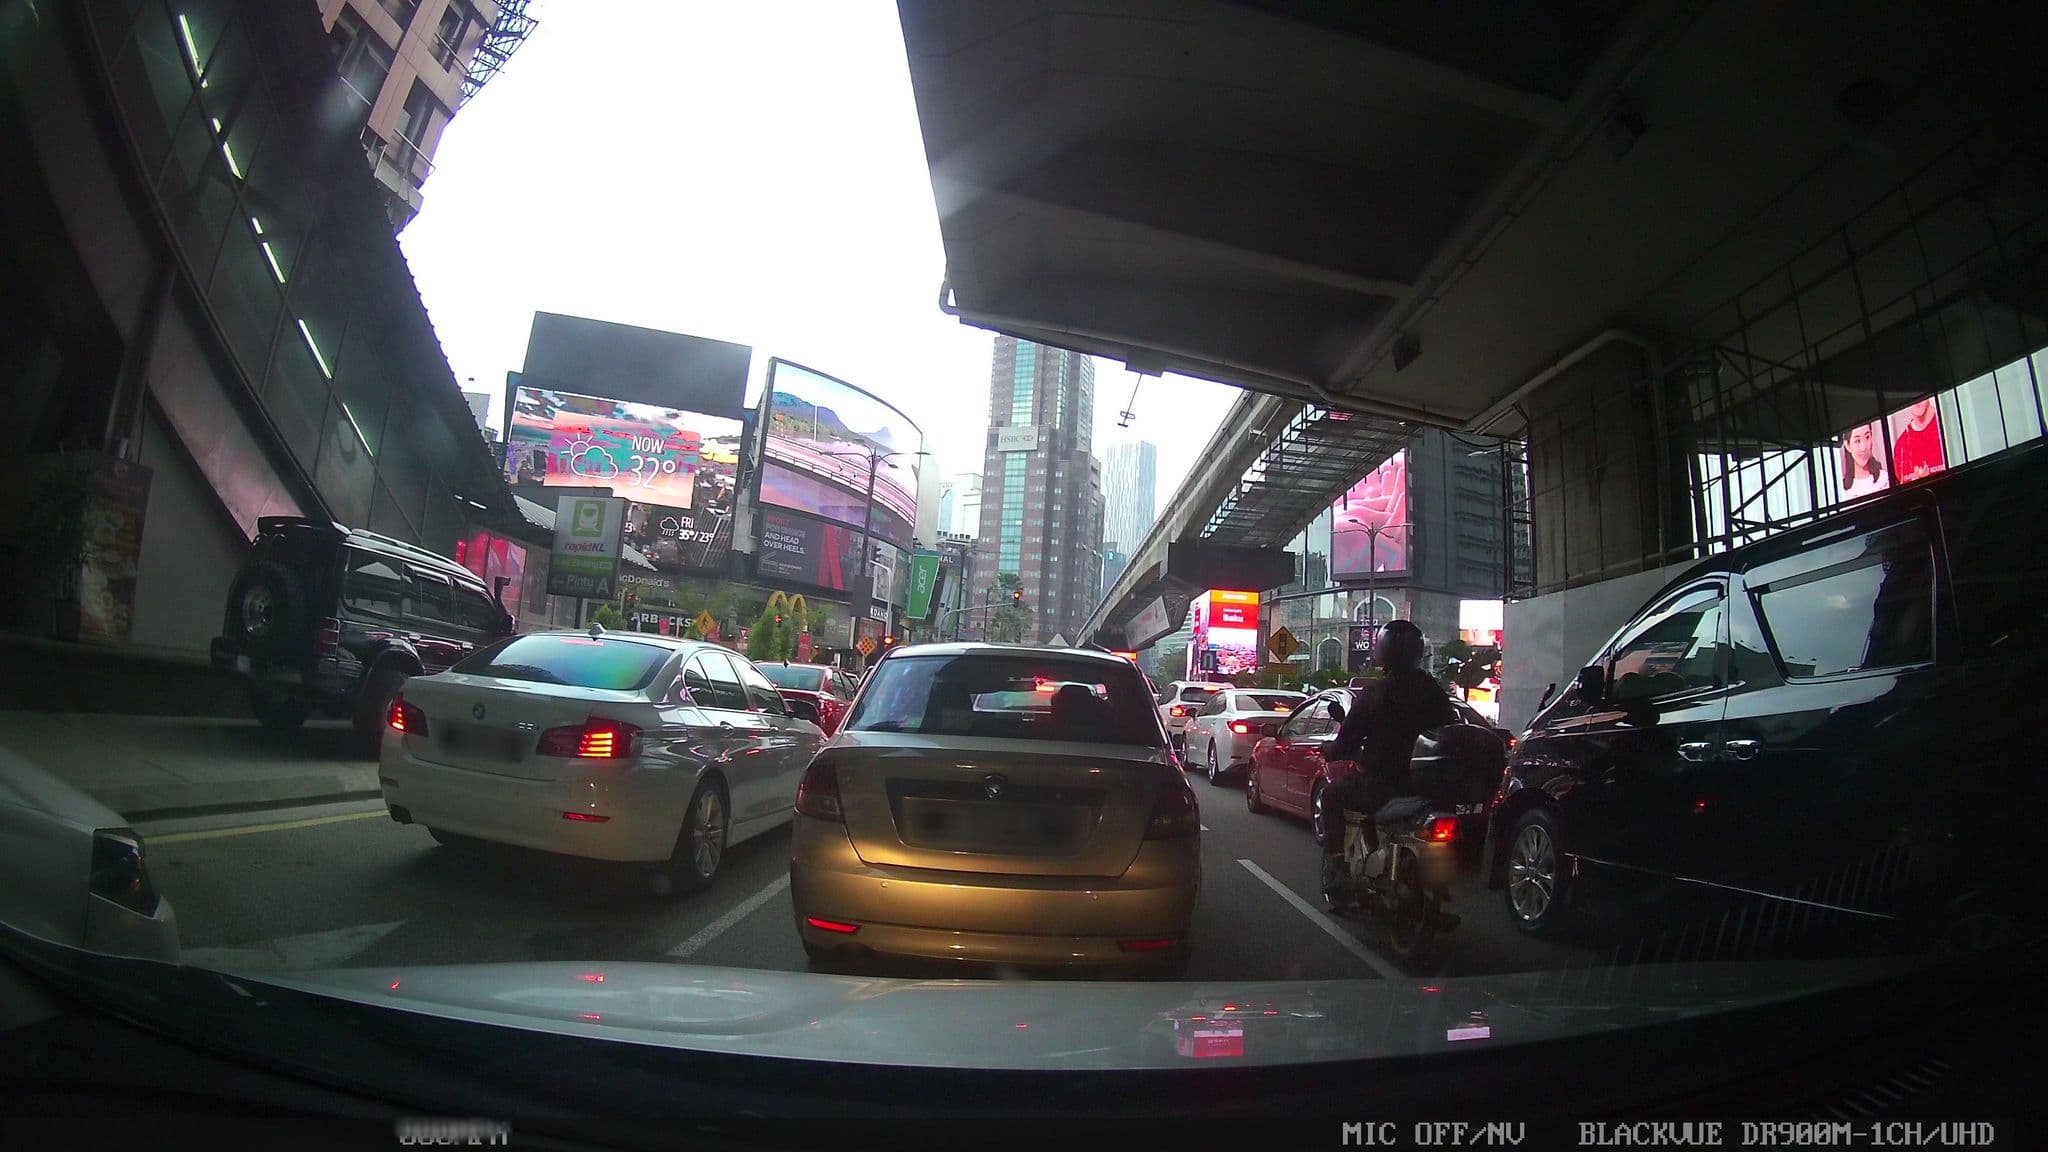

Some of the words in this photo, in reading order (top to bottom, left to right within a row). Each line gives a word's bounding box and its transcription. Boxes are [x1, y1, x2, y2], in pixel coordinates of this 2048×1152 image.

[632, 435, 665, 454] NOW
[681, 516, 694, 529] FRI
[763, 539, 783, 550] OVER
[764, 531, 780, 541] AND
[780, 535, 800, 545] HEAD
[917, 565, 927, 594] acer
